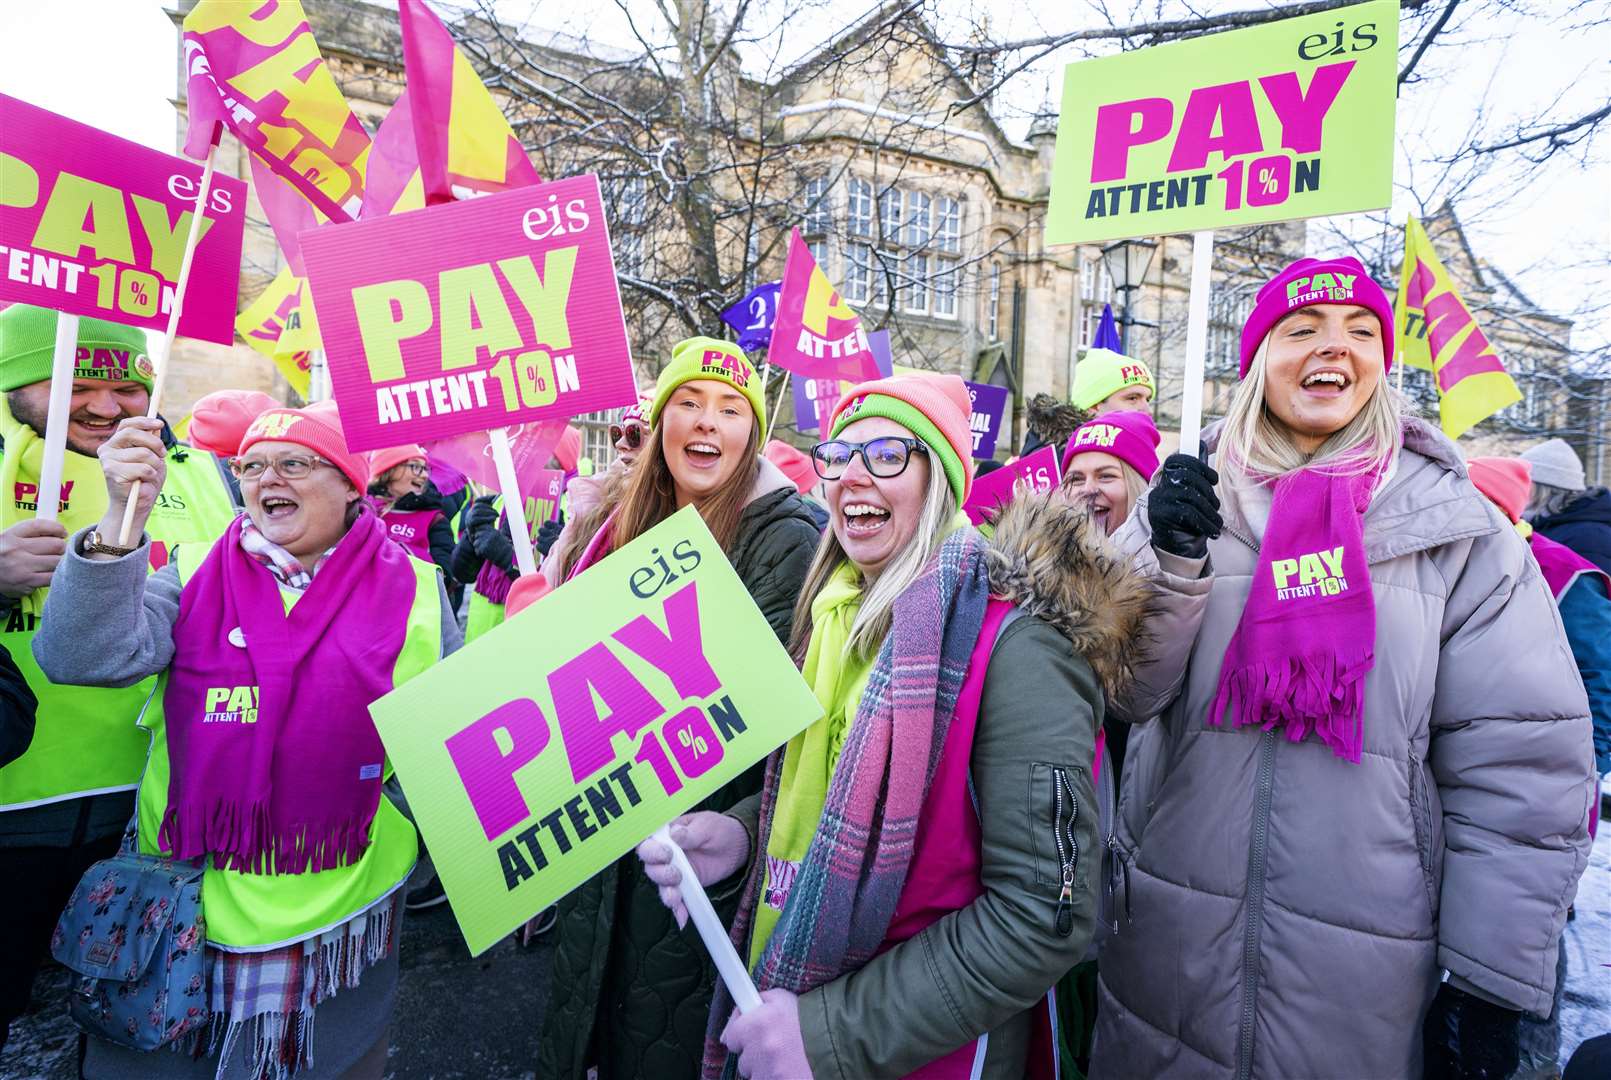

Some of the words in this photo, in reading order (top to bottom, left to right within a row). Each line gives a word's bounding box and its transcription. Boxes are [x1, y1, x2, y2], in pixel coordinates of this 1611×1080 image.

[1298, 21, 1378, 61] eis
[1090, 60, 1357, 183] PAY
[168, 174, 232, 213] es
[522, 194, 590, 240] eis
[1287, 272, 1357, 299] PAY
[351, 245, 579, 384] PAY
[75, 347, 130, 369] PAY
[702, 350, 751, 380] PAY
[15, 480, 74, 503] PY
[391, 524, 415, 537] eis
[629, 539, 701, 599] eis
[1272, 546, 1344, 589] PAY
[444, 580, 722, 842] PAY
